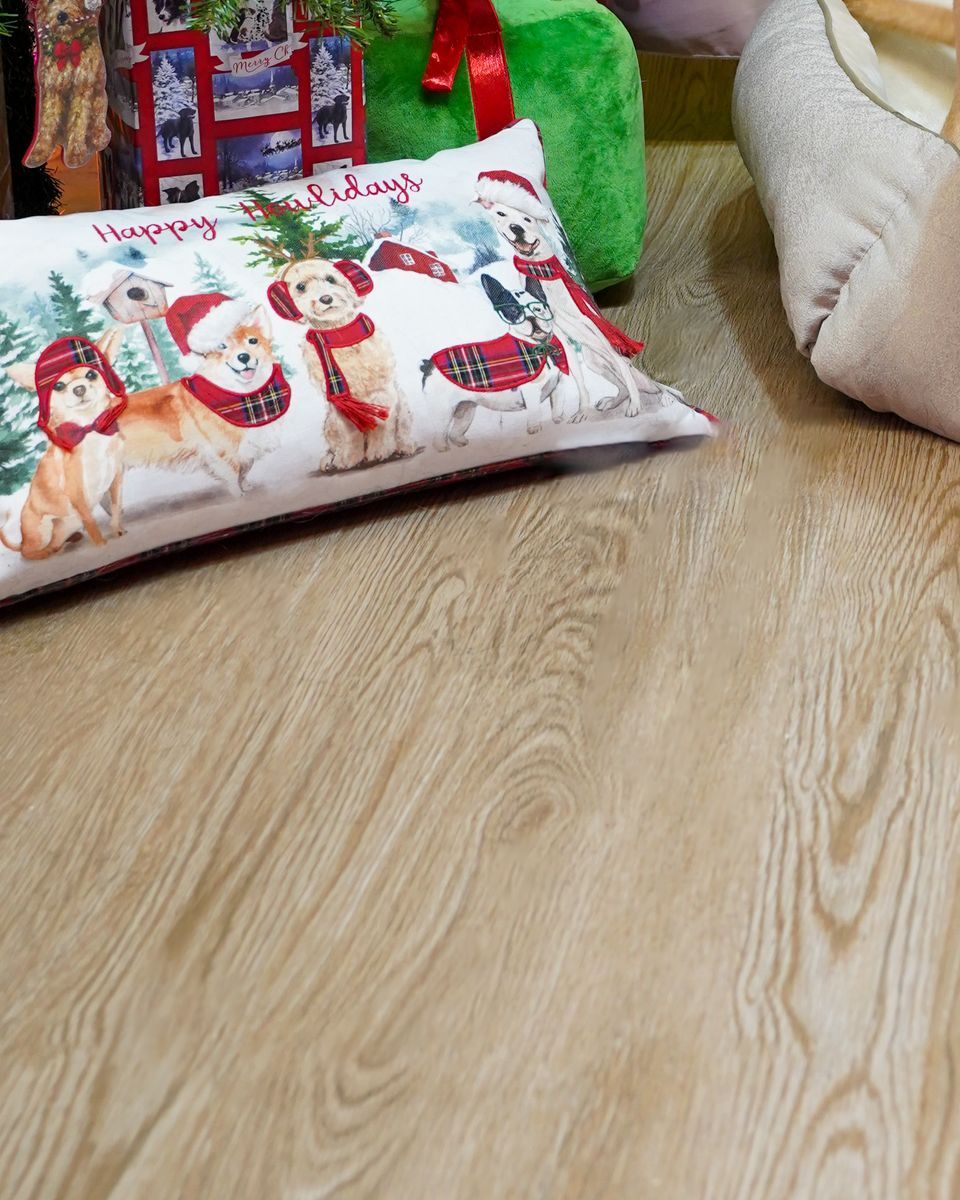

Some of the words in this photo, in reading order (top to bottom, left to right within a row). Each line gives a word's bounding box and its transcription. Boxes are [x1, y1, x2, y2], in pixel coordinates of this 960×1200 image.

[232, 57, 272, 73] Merry
[91, 214, 218, 246] Happy
[239, 172, 423, 222] Howlidays
